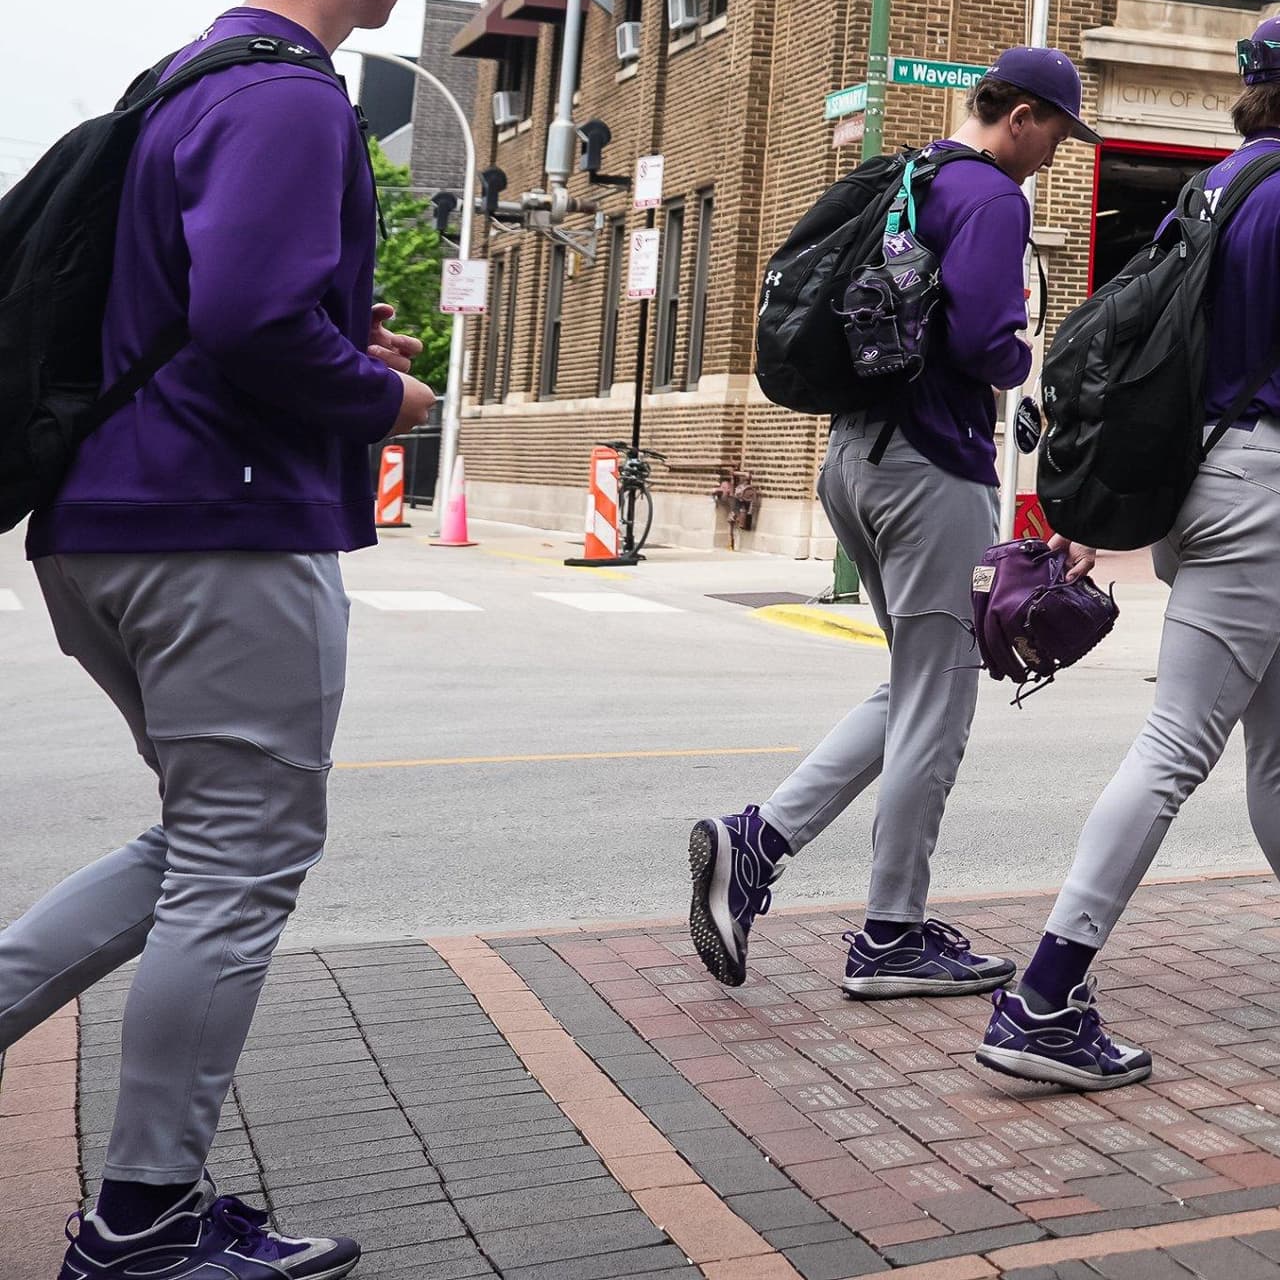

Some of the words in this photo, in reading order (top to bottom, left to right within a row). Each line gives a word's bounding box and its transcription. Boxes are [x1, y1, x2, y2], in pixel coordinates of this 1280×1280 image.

[899, 65, 909, 77] W
[912, 63, 983, 86] Wavelan
[1122, 86, 1161, 104] CITY
[1169, 90, 1196, 108] OF
